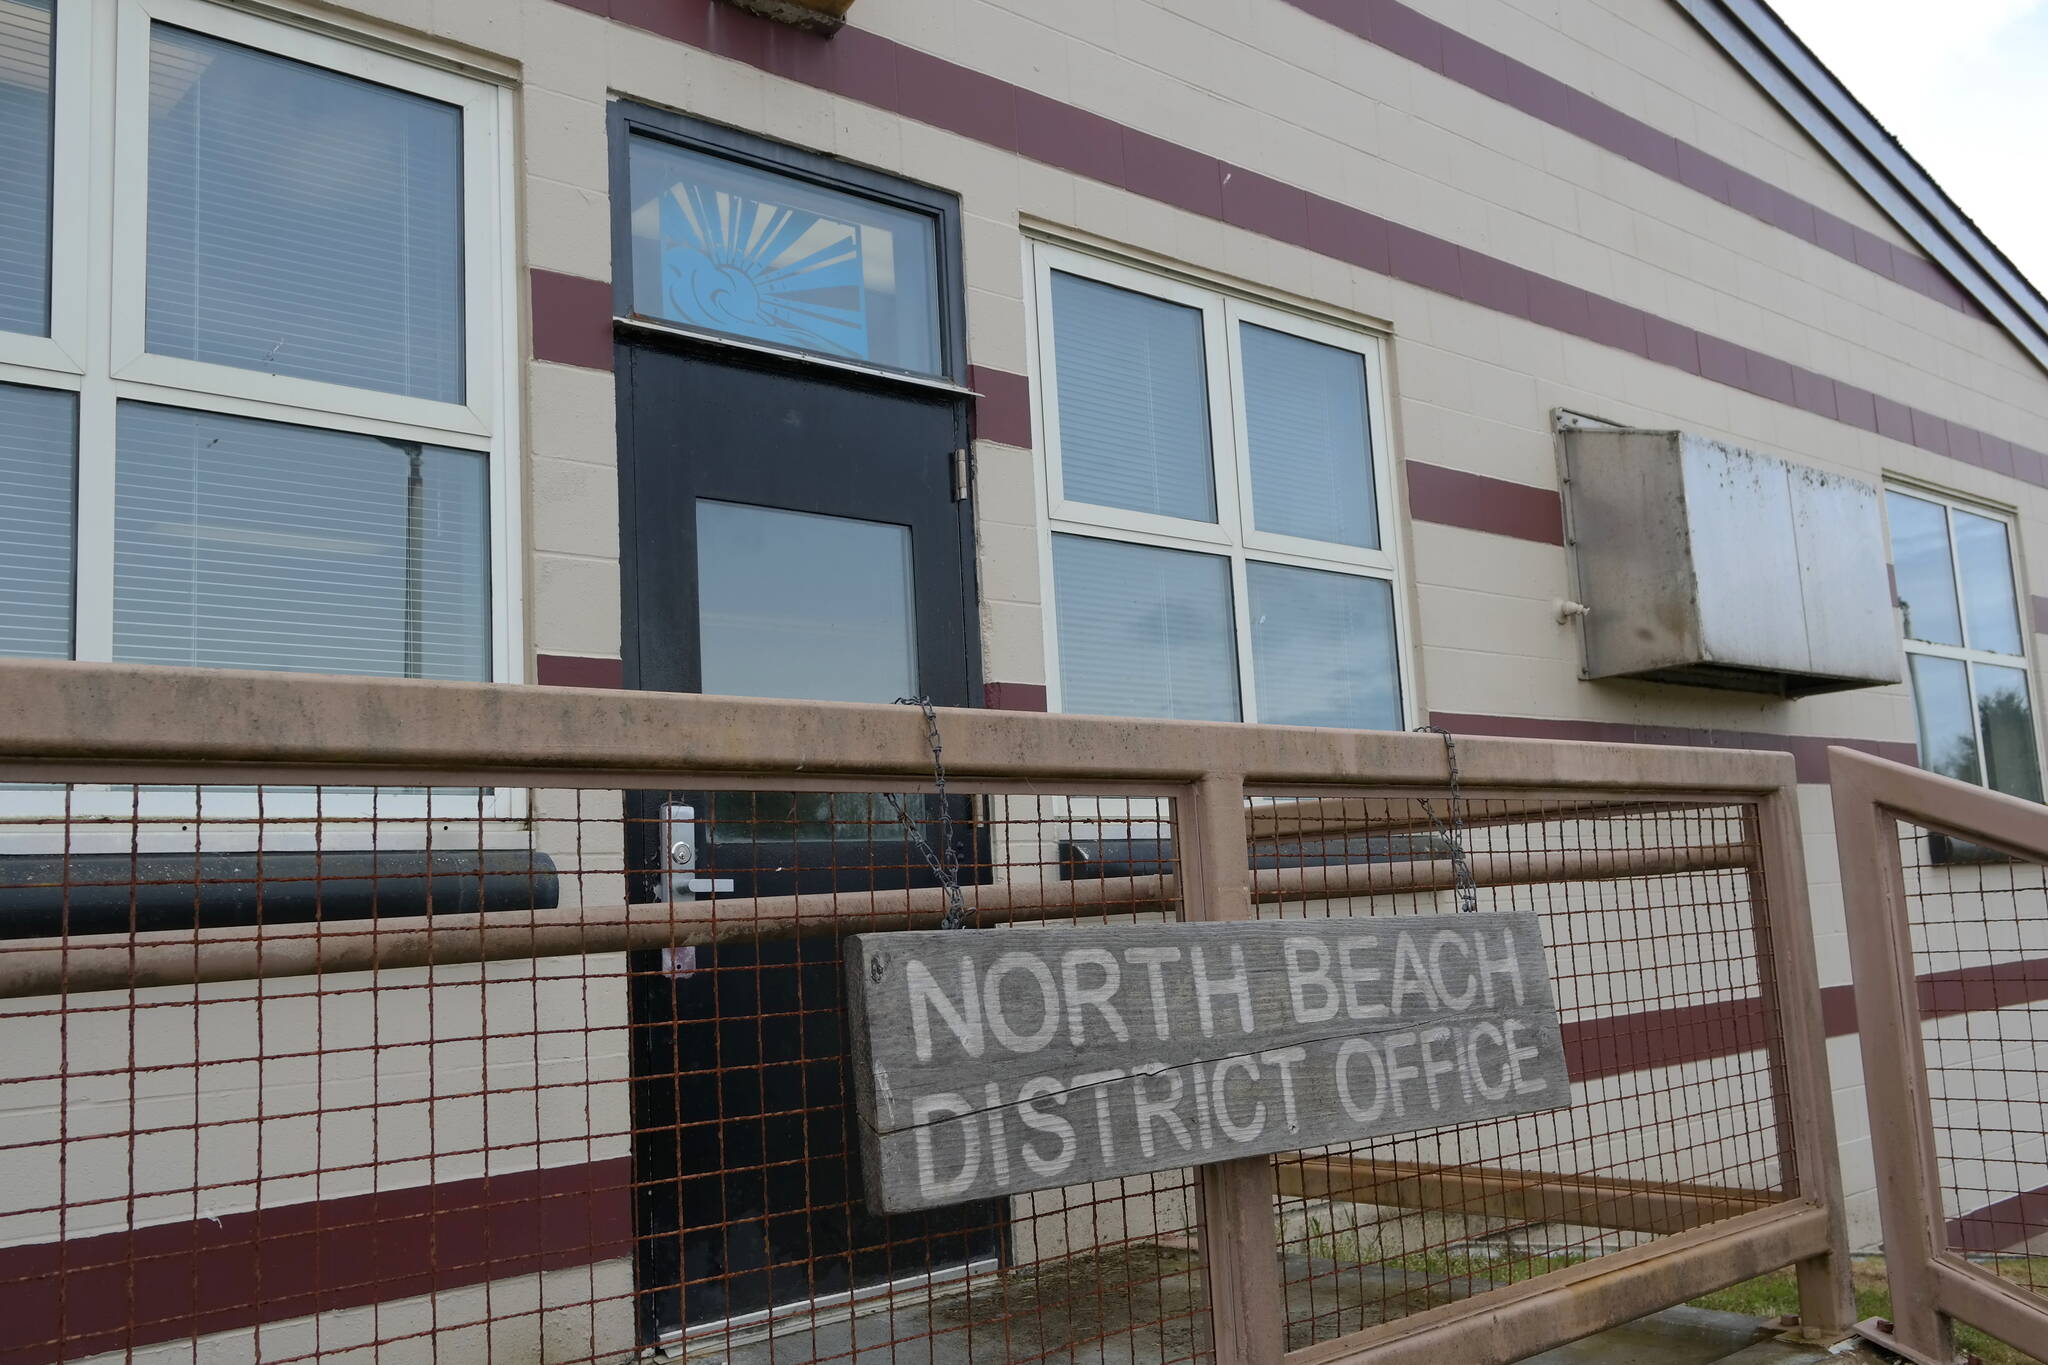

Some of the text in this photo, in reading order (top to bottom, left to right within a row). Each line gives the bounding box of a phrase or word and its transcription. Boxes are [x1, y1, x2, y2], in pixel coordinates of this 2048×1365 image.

[905, 927, 1526, 1062] NORTH BEACH
[912, 1018, 1549, 1202] DISTRICT OFFICE
